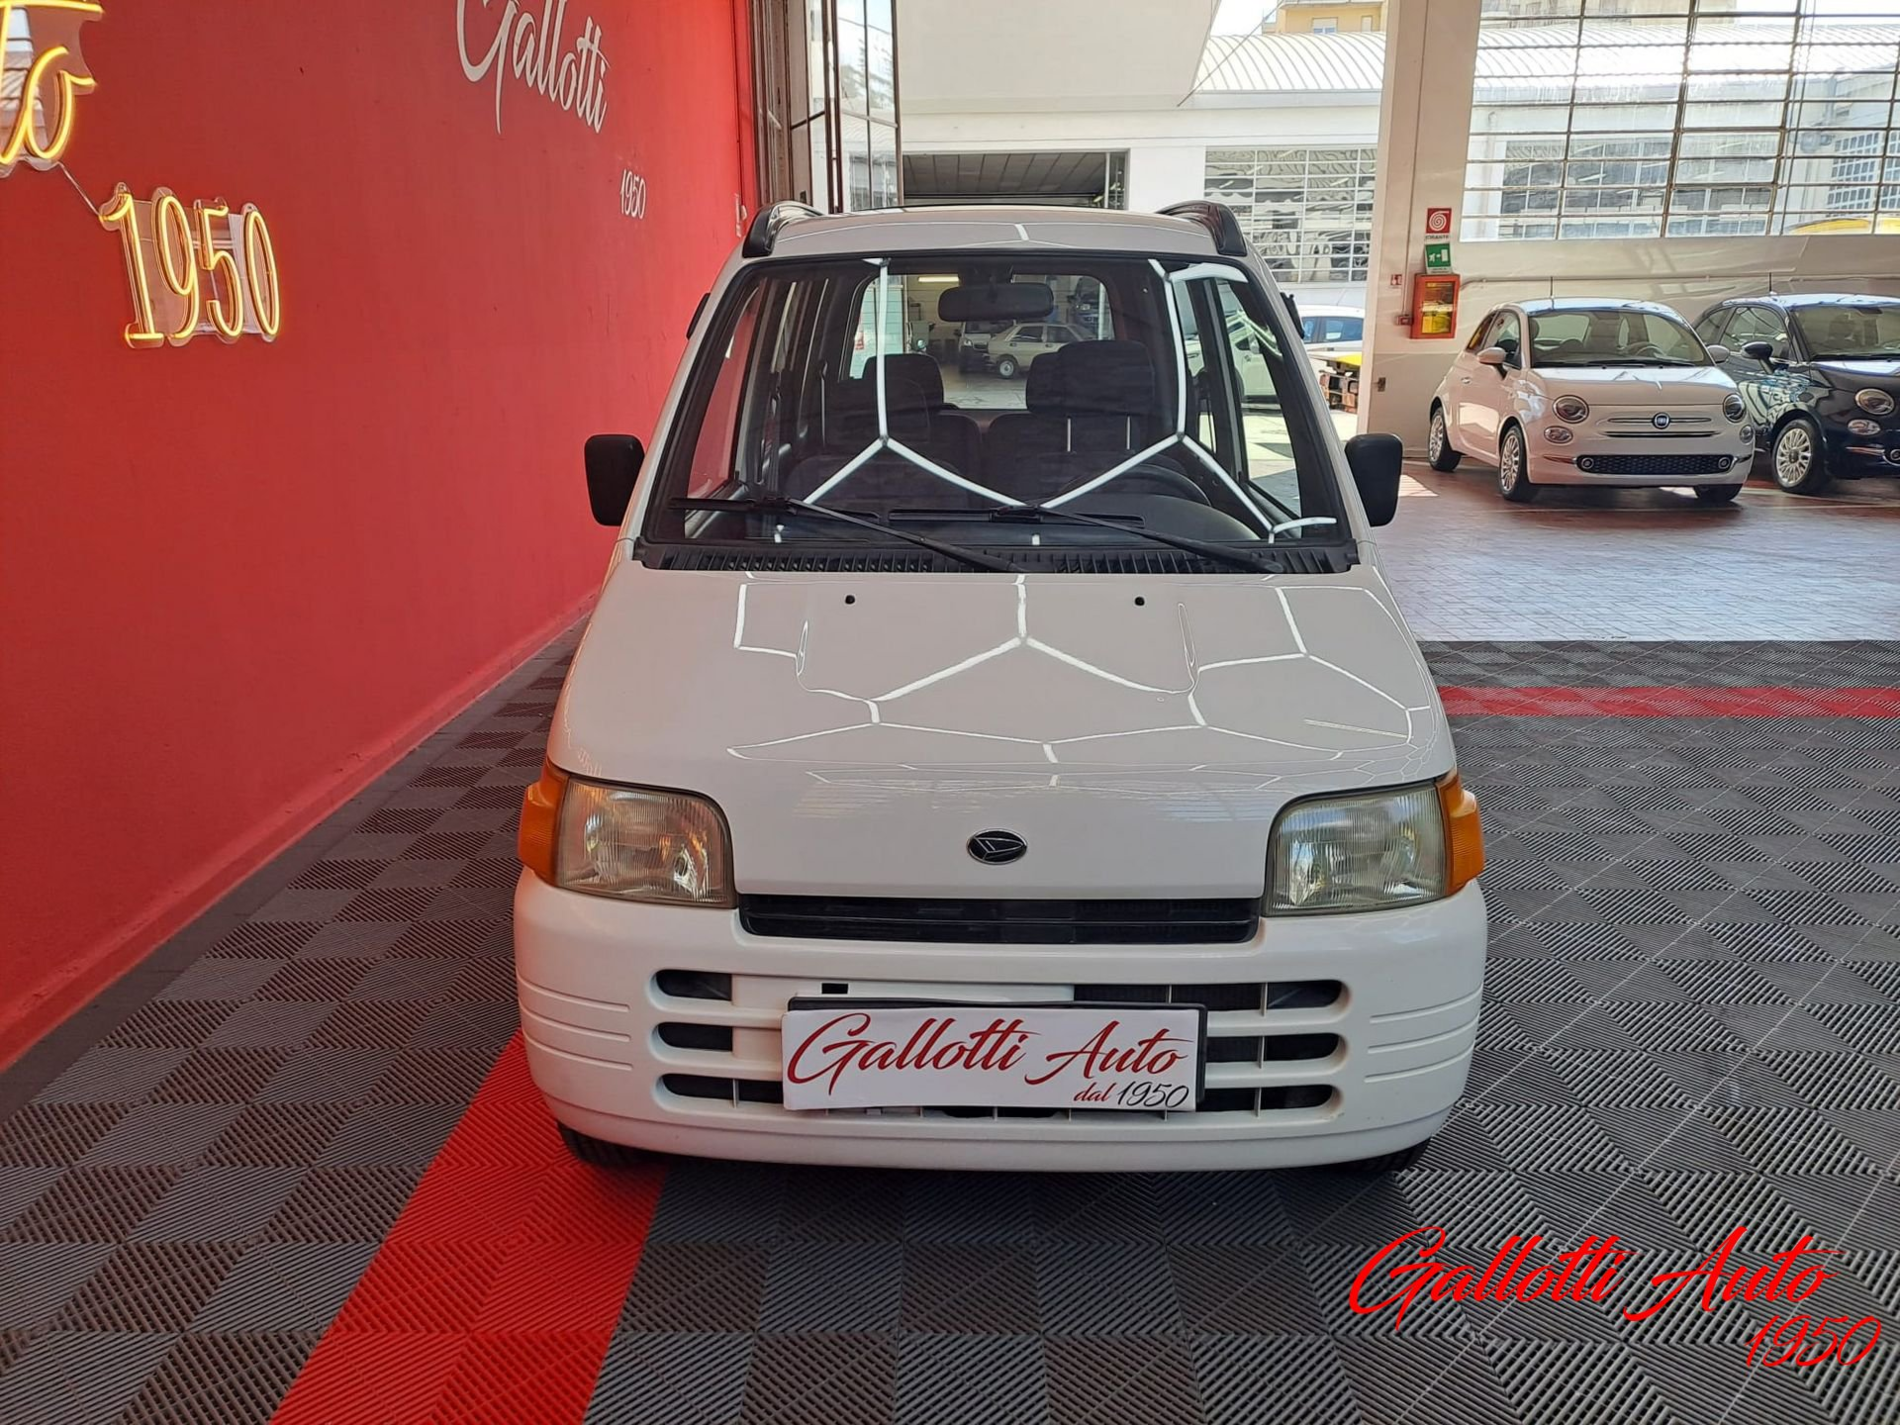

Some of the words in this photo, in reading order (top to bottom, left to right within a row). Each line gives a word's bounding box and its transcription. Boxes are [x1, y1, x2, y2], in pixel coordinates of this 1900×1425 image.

[620, 169, 646, 219] 1950
[99, 193, 281, 340] 1950
[787, 1012, 1042, 1096] Gallotti
[1024, 1020, 1194, 1086] Auto
[1073, 1081, 1111, 1102] dal
[1117, 1081, 1190, 1108] 1950
